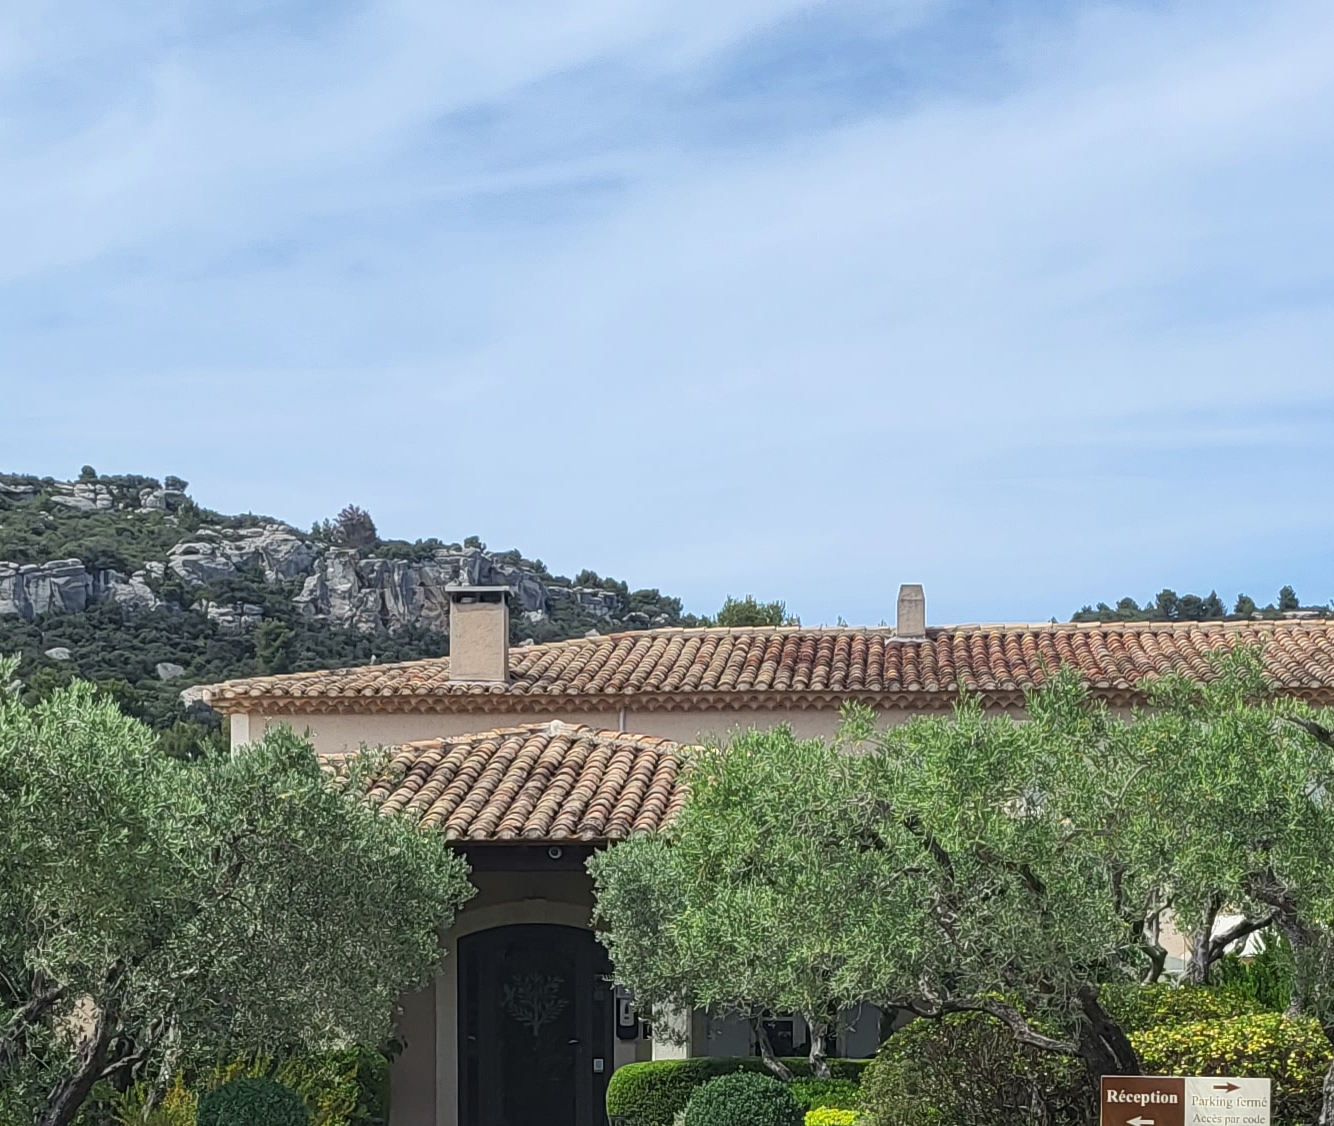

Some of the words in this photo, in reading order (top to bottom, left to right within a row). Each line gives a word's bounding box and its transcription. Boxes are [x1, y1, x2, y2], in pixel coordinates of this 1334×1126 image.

[1106, 1088, 1179, 1108] Réception
[1192, 1095, 1233, 1109] Parking
[1236, 1096, 1268, 1108] fermé
[1192, 1113, 1223, 1124] Accès
[1224, 1116, 1241, 1126] par
[1242, 1115, 1266, 1125] code
